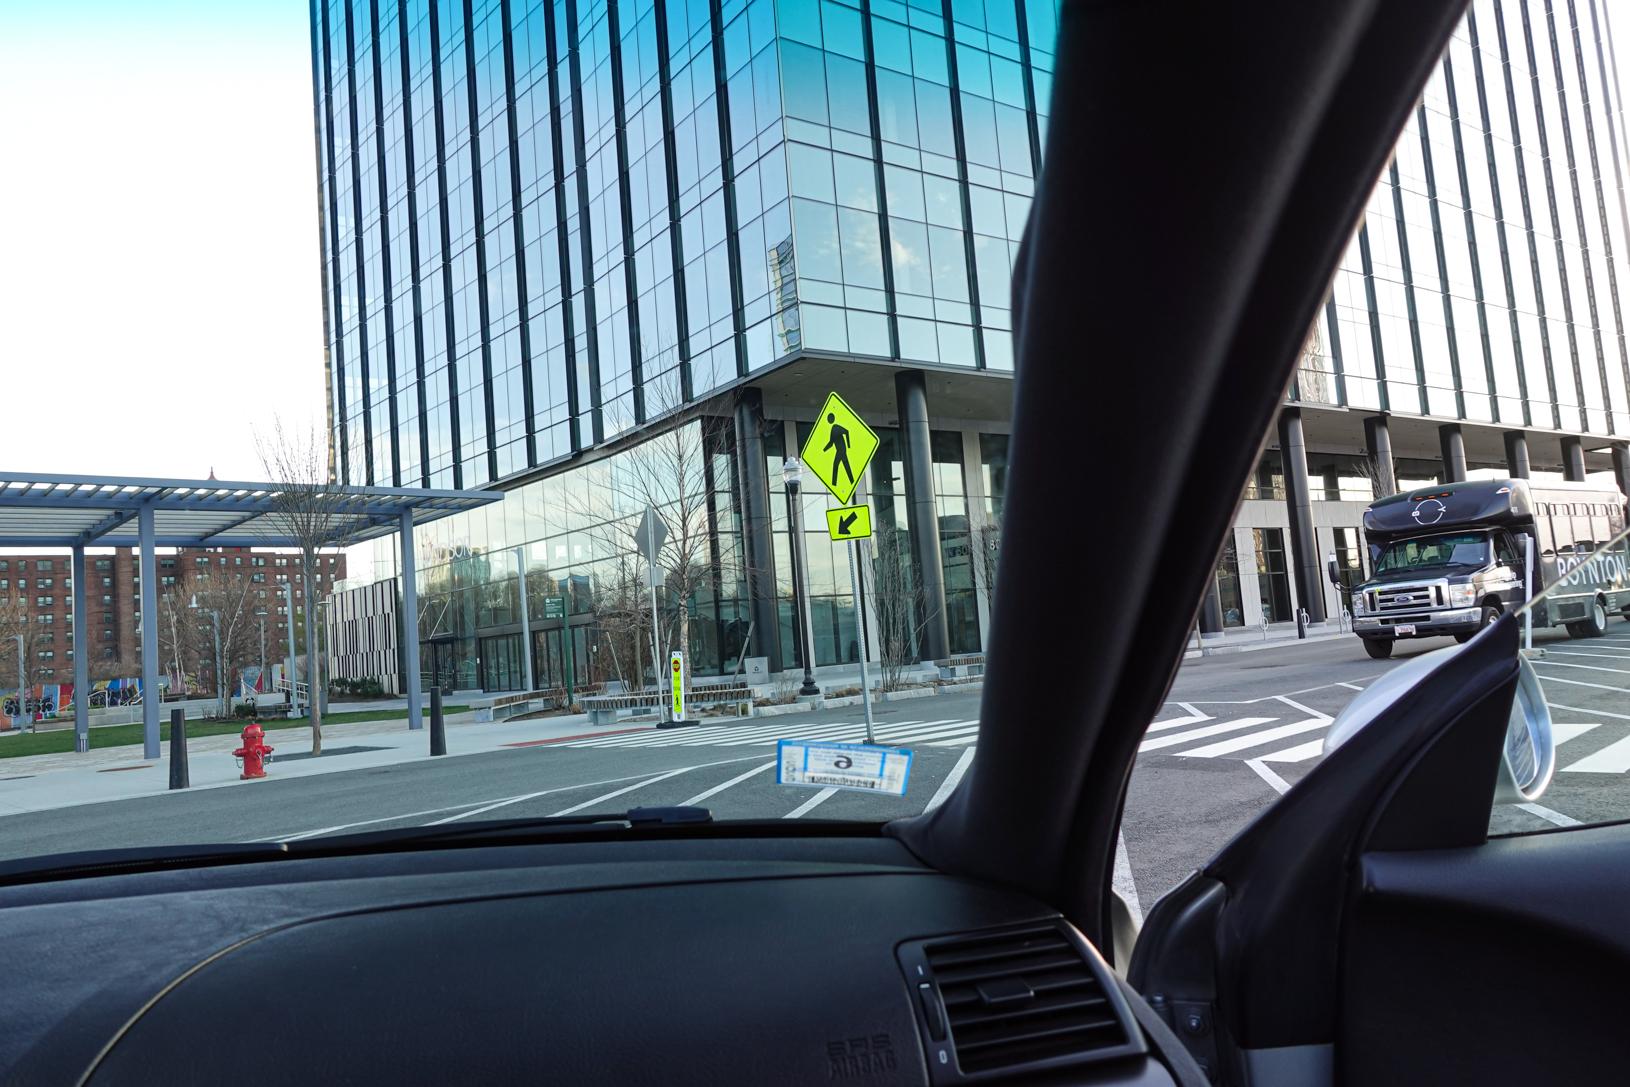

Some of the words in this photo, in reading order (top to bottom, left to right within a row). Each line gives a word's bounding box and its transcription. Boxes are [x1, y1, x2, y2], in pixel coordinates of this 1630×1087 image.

[1556, 555, 1628, 587] BOYNTON
[827, 1033, 891, 1056] SRS
[829, 1049, 898, 1080] AIRBAG
